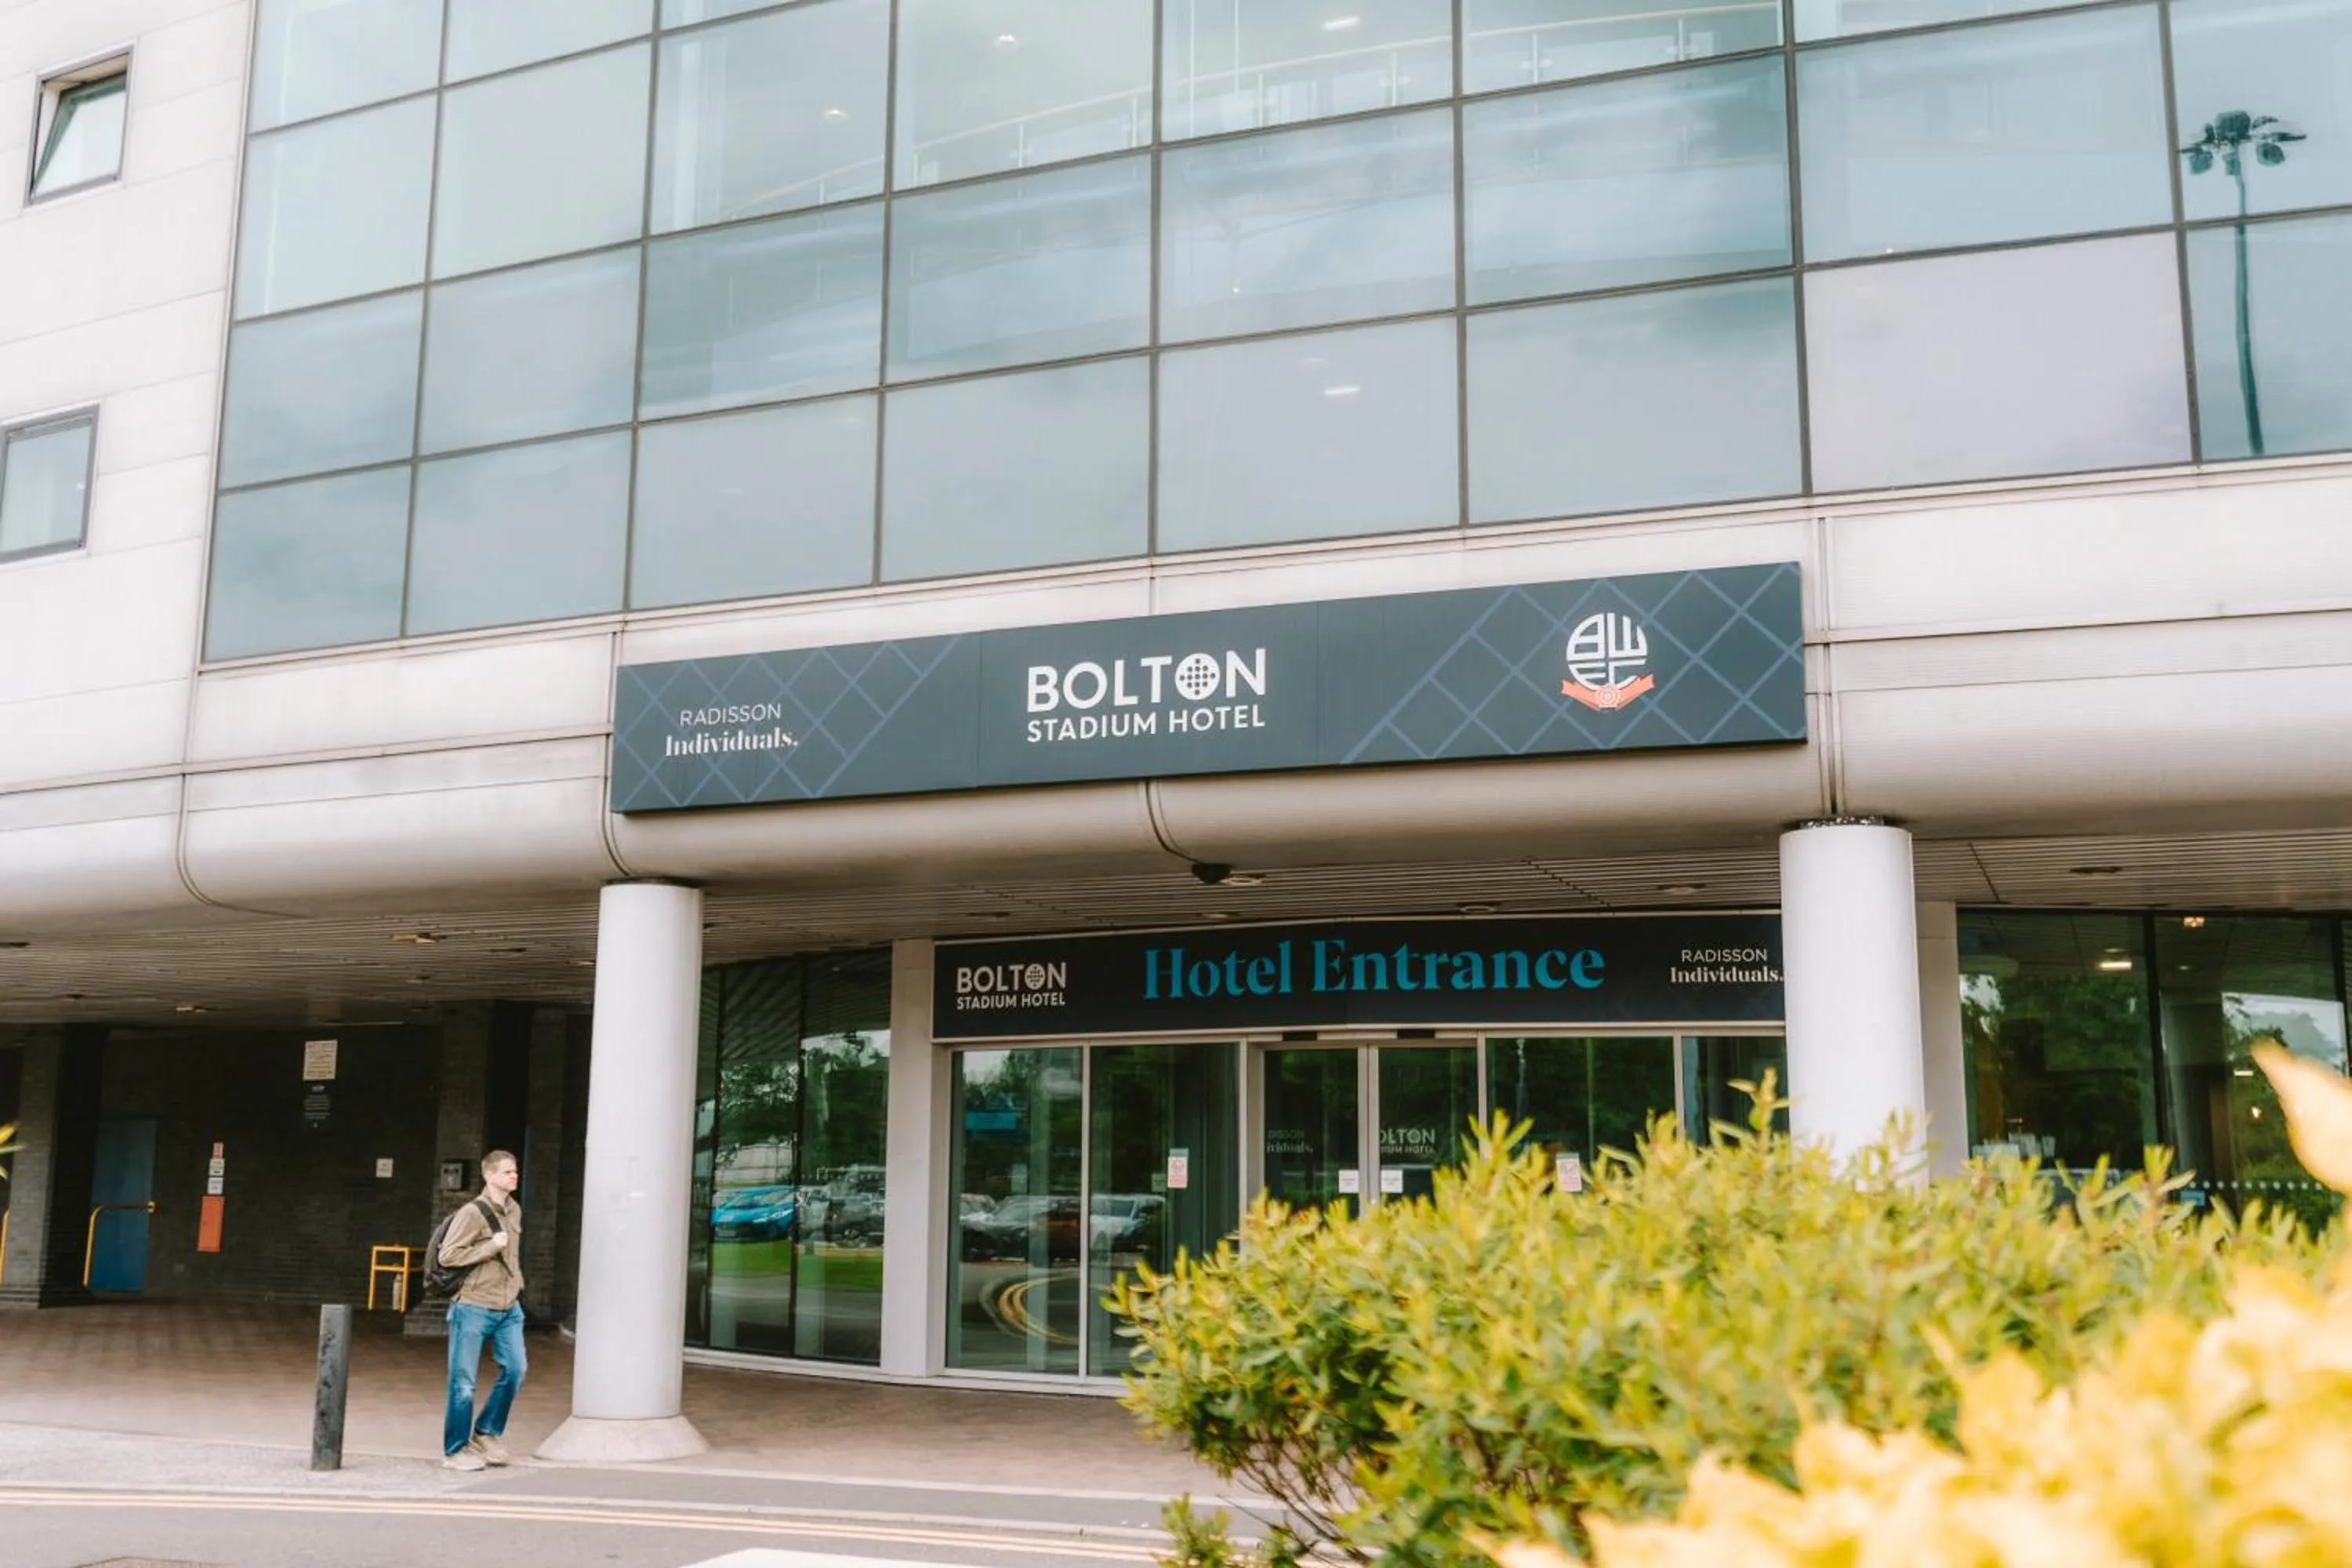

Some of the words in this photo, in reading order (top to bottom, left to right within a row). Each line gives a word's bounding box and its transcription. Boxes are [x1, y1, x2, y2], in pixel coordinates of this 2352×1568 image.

[1027, 648, 1266, 713] BOLTON
[680, 702, 782, 727] RADISSON
[1027, 711, 1156, 742] STADIUM
[1169, 703, 1265, 733] HOTEL
[666, 727, 798, 757] Individuals.
[1143, 940, 1292, 1000] Hotel
[1312, 939, 1606, 992] Entrance
[1681, 947, 1768, 964] RADISSON
[956, 961, 1067, 993] BOLTON
[956, 994, 1017, 1010] STADIUM
[1022, 991, 1065, 1007] HOTEL
